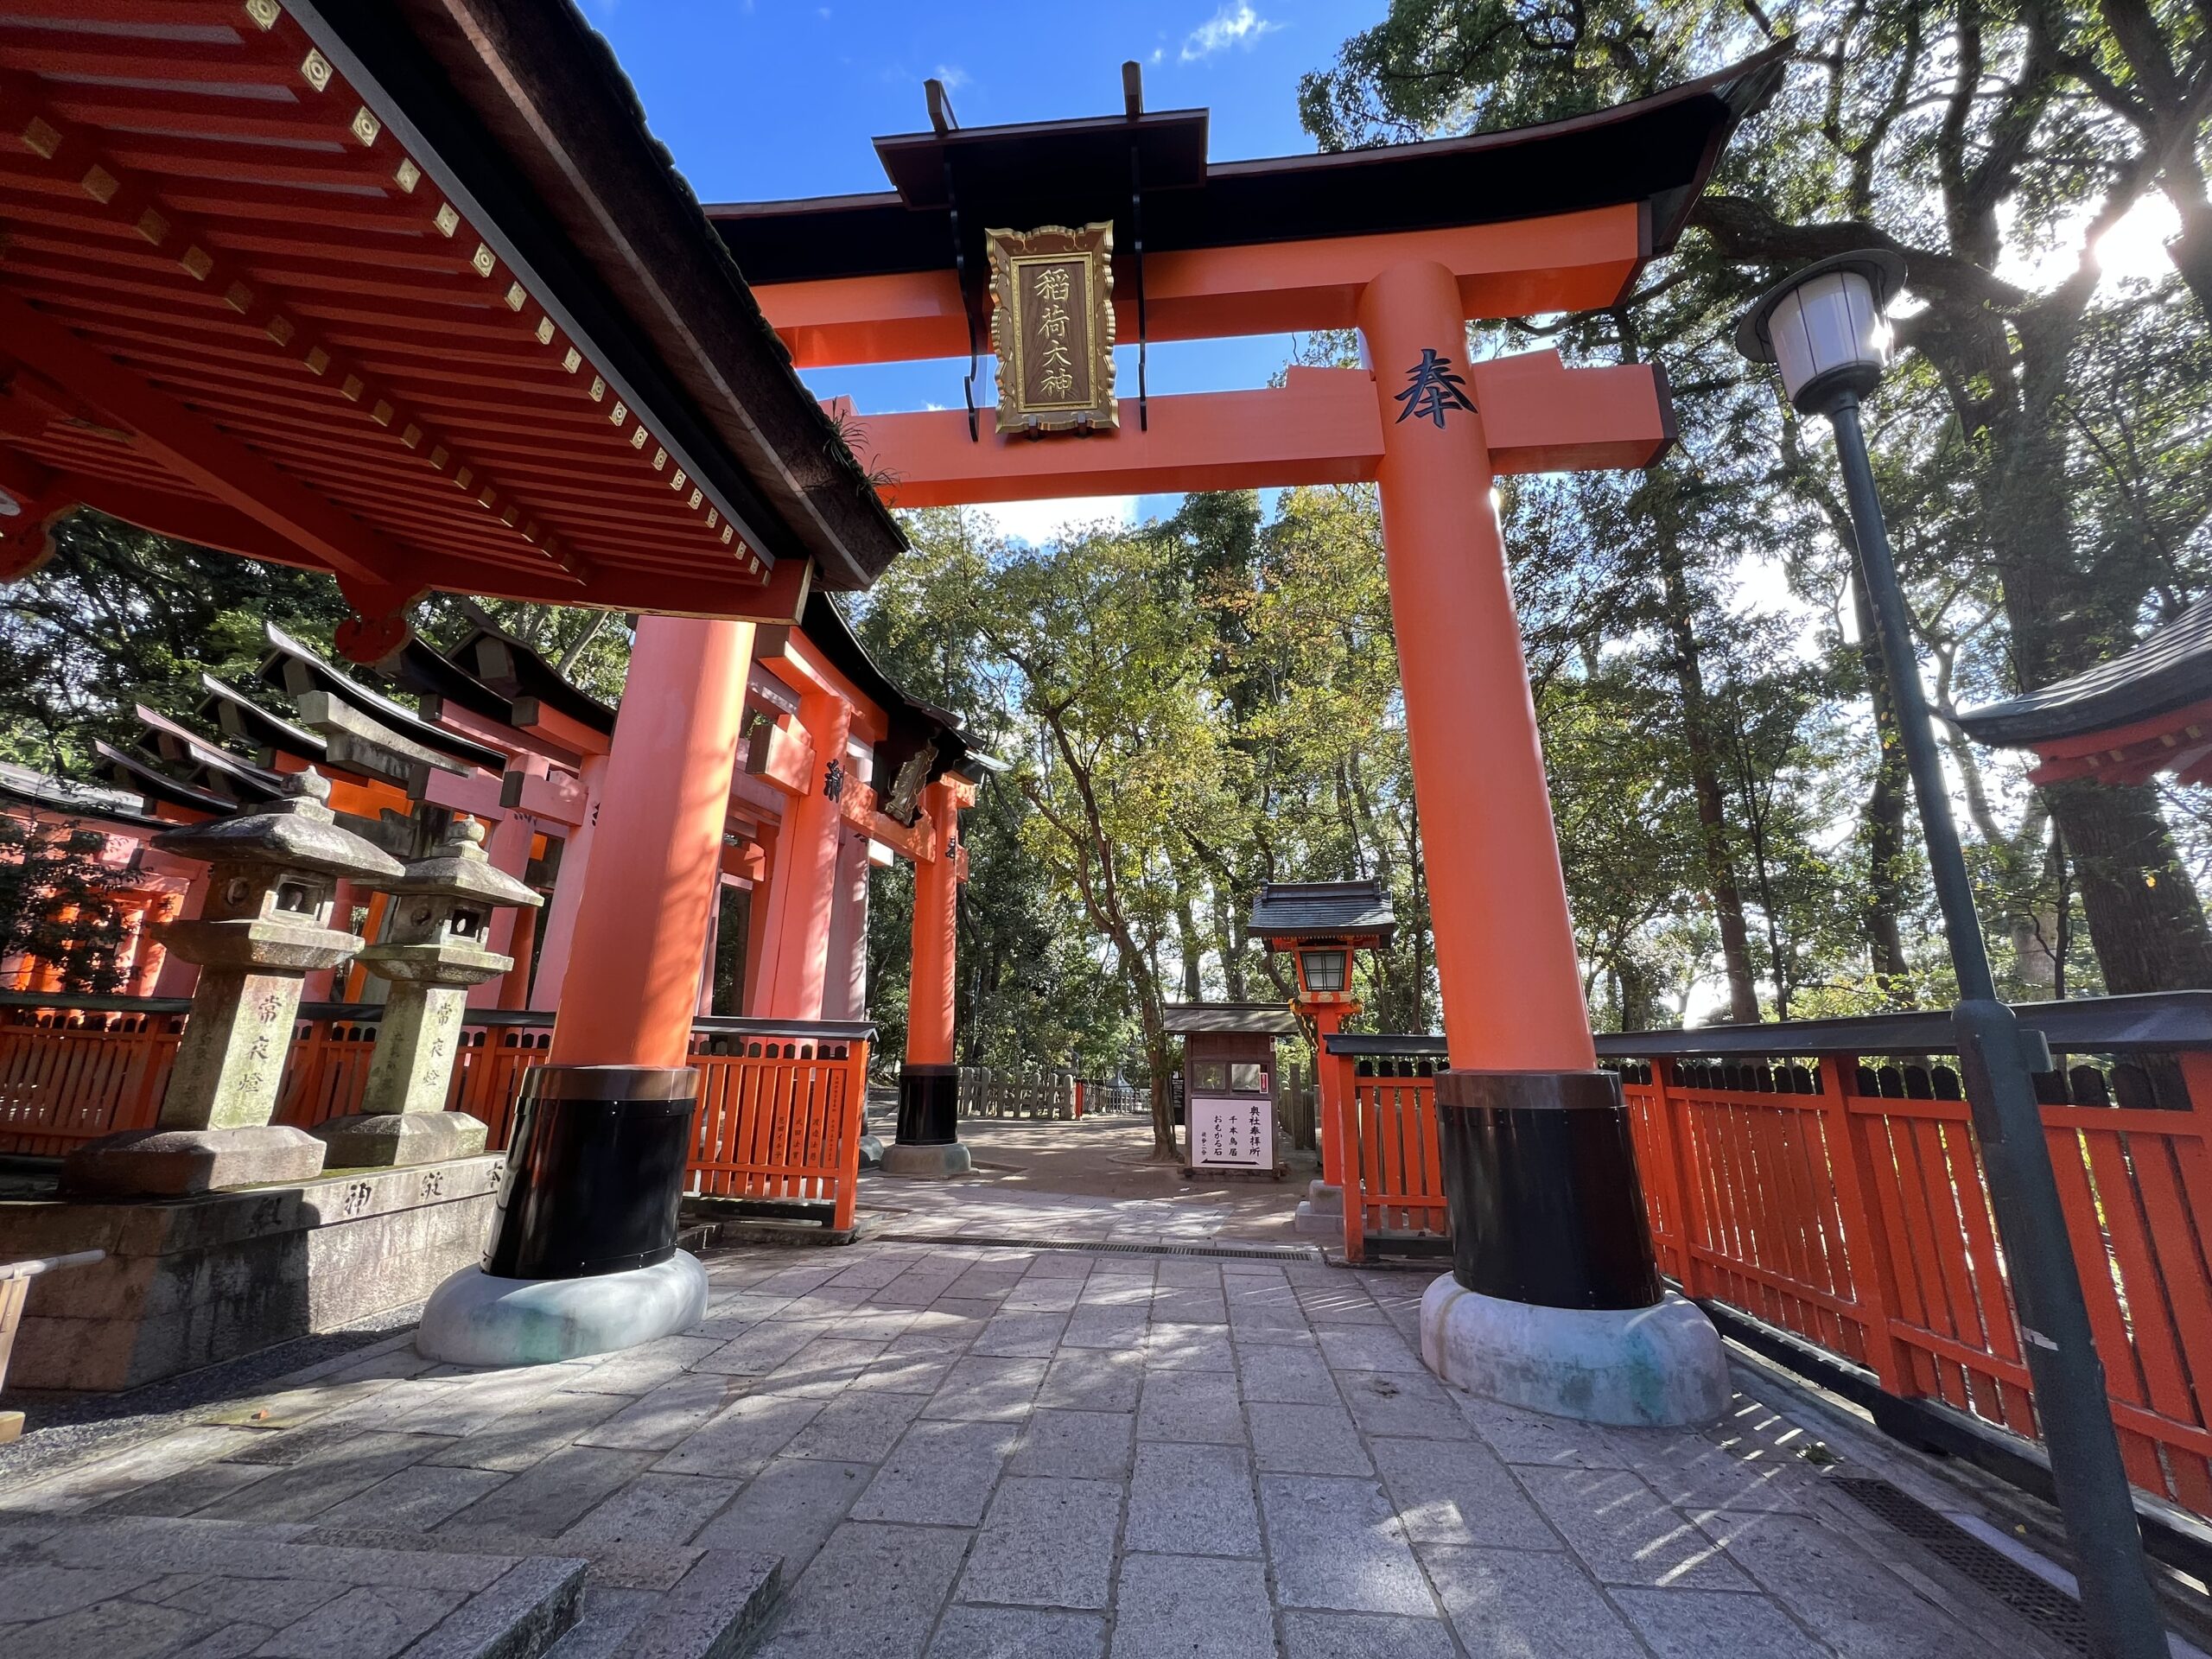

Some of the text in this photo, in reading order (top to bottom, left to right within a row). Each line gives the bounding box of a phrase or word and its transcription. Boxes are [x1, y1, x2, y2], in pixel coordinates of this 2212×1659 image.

[1394, 348, 1478, 429] 奉
[1214, 1115, 1223, 1156] おもかる石
[1229, 1116, 1238, 1156] 千本鳥居
